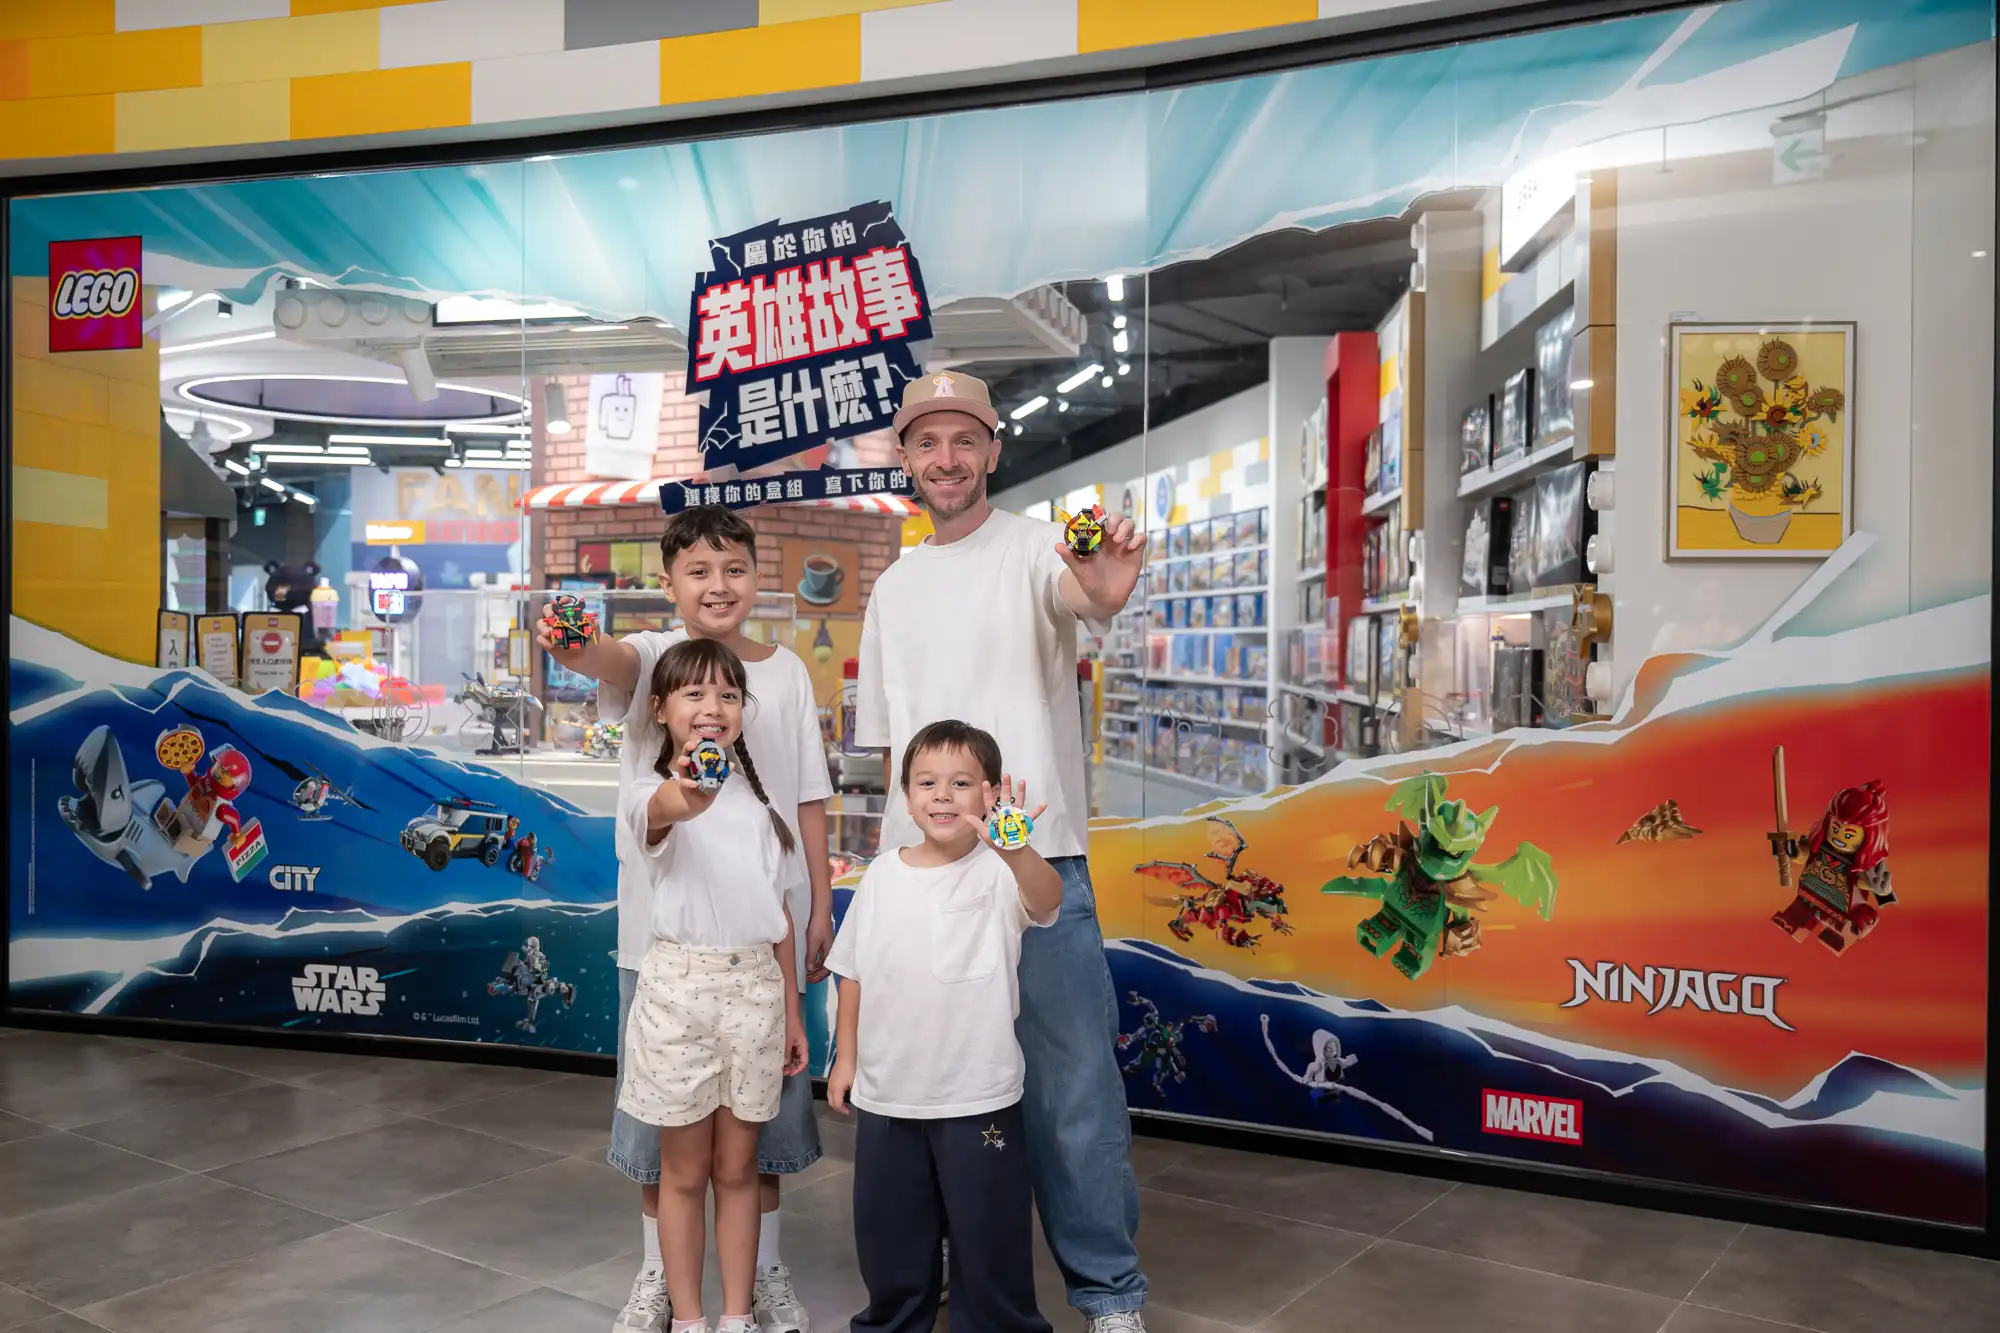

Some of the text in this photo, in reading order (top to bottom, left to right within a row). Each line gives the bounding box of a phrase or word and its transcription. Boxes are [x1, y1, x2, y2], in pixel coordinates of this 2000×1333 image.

[744, 219, 857, 268] 屬於你的
[54, 269, 137, 318] LEGO
[697, 247, 920, 381] 英雄故事
[684, 469, 914, 506] 選擇你的盒組 寫下你的
[236, 840, 261, 867] PIZZA
[269, 865, 321, 892] CITY
[292, 963, 386, 992] STAR
[1560, 958, 1796, 1032] NINJAGO
[292, 986, 386, 1016] WARS
[433, 1014, 466, 1024] Lucasfilm
[1485, 1093, 1580, 1140] MARVEL
